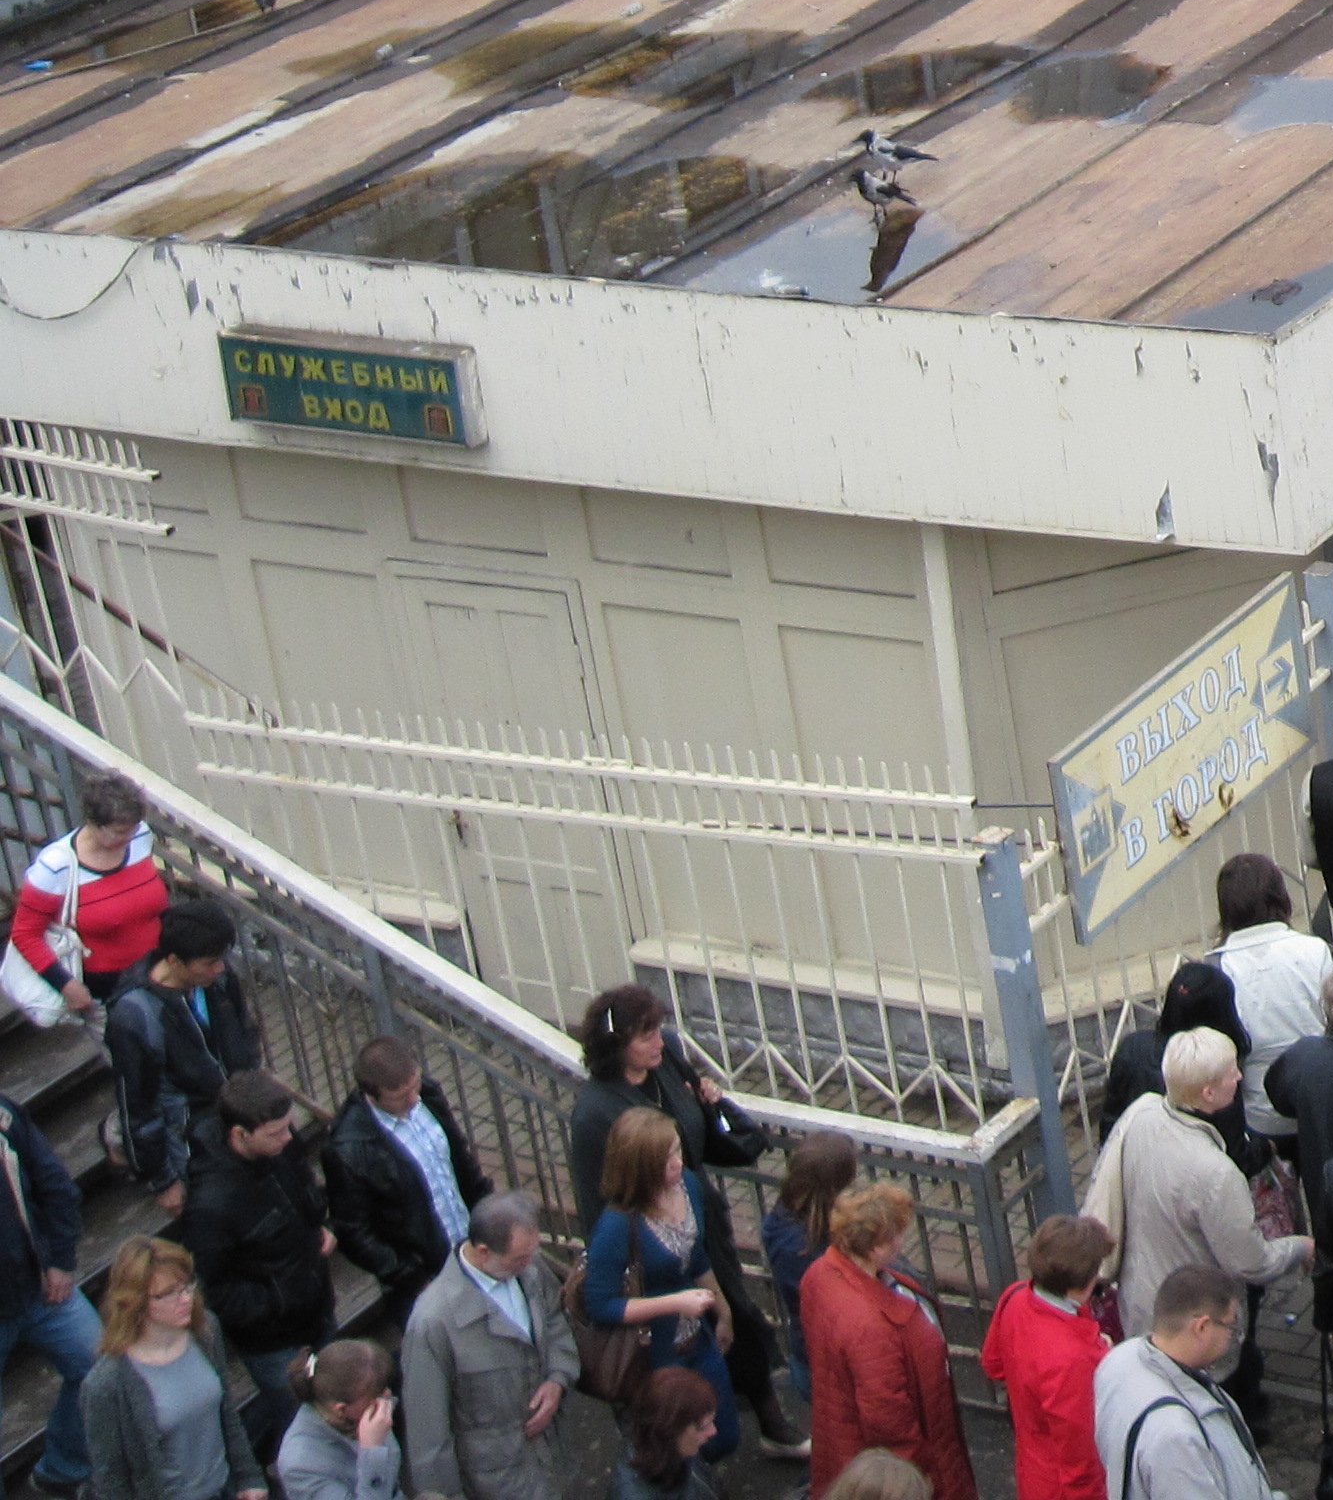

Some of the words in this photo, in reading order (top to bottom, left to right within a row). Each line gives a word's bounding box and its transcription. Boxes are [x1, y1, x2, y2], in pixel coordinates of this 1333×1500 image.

[234, 348, 449, 394] СЛУЖЕБНЫЙ
[301, 391, 392, 431] ВХОД
[1115, 644, 1247, 785] ВЫХОД
[1120, 815, 1148, 870] В
[1153, 714, 1269, 844] ГОРОД
